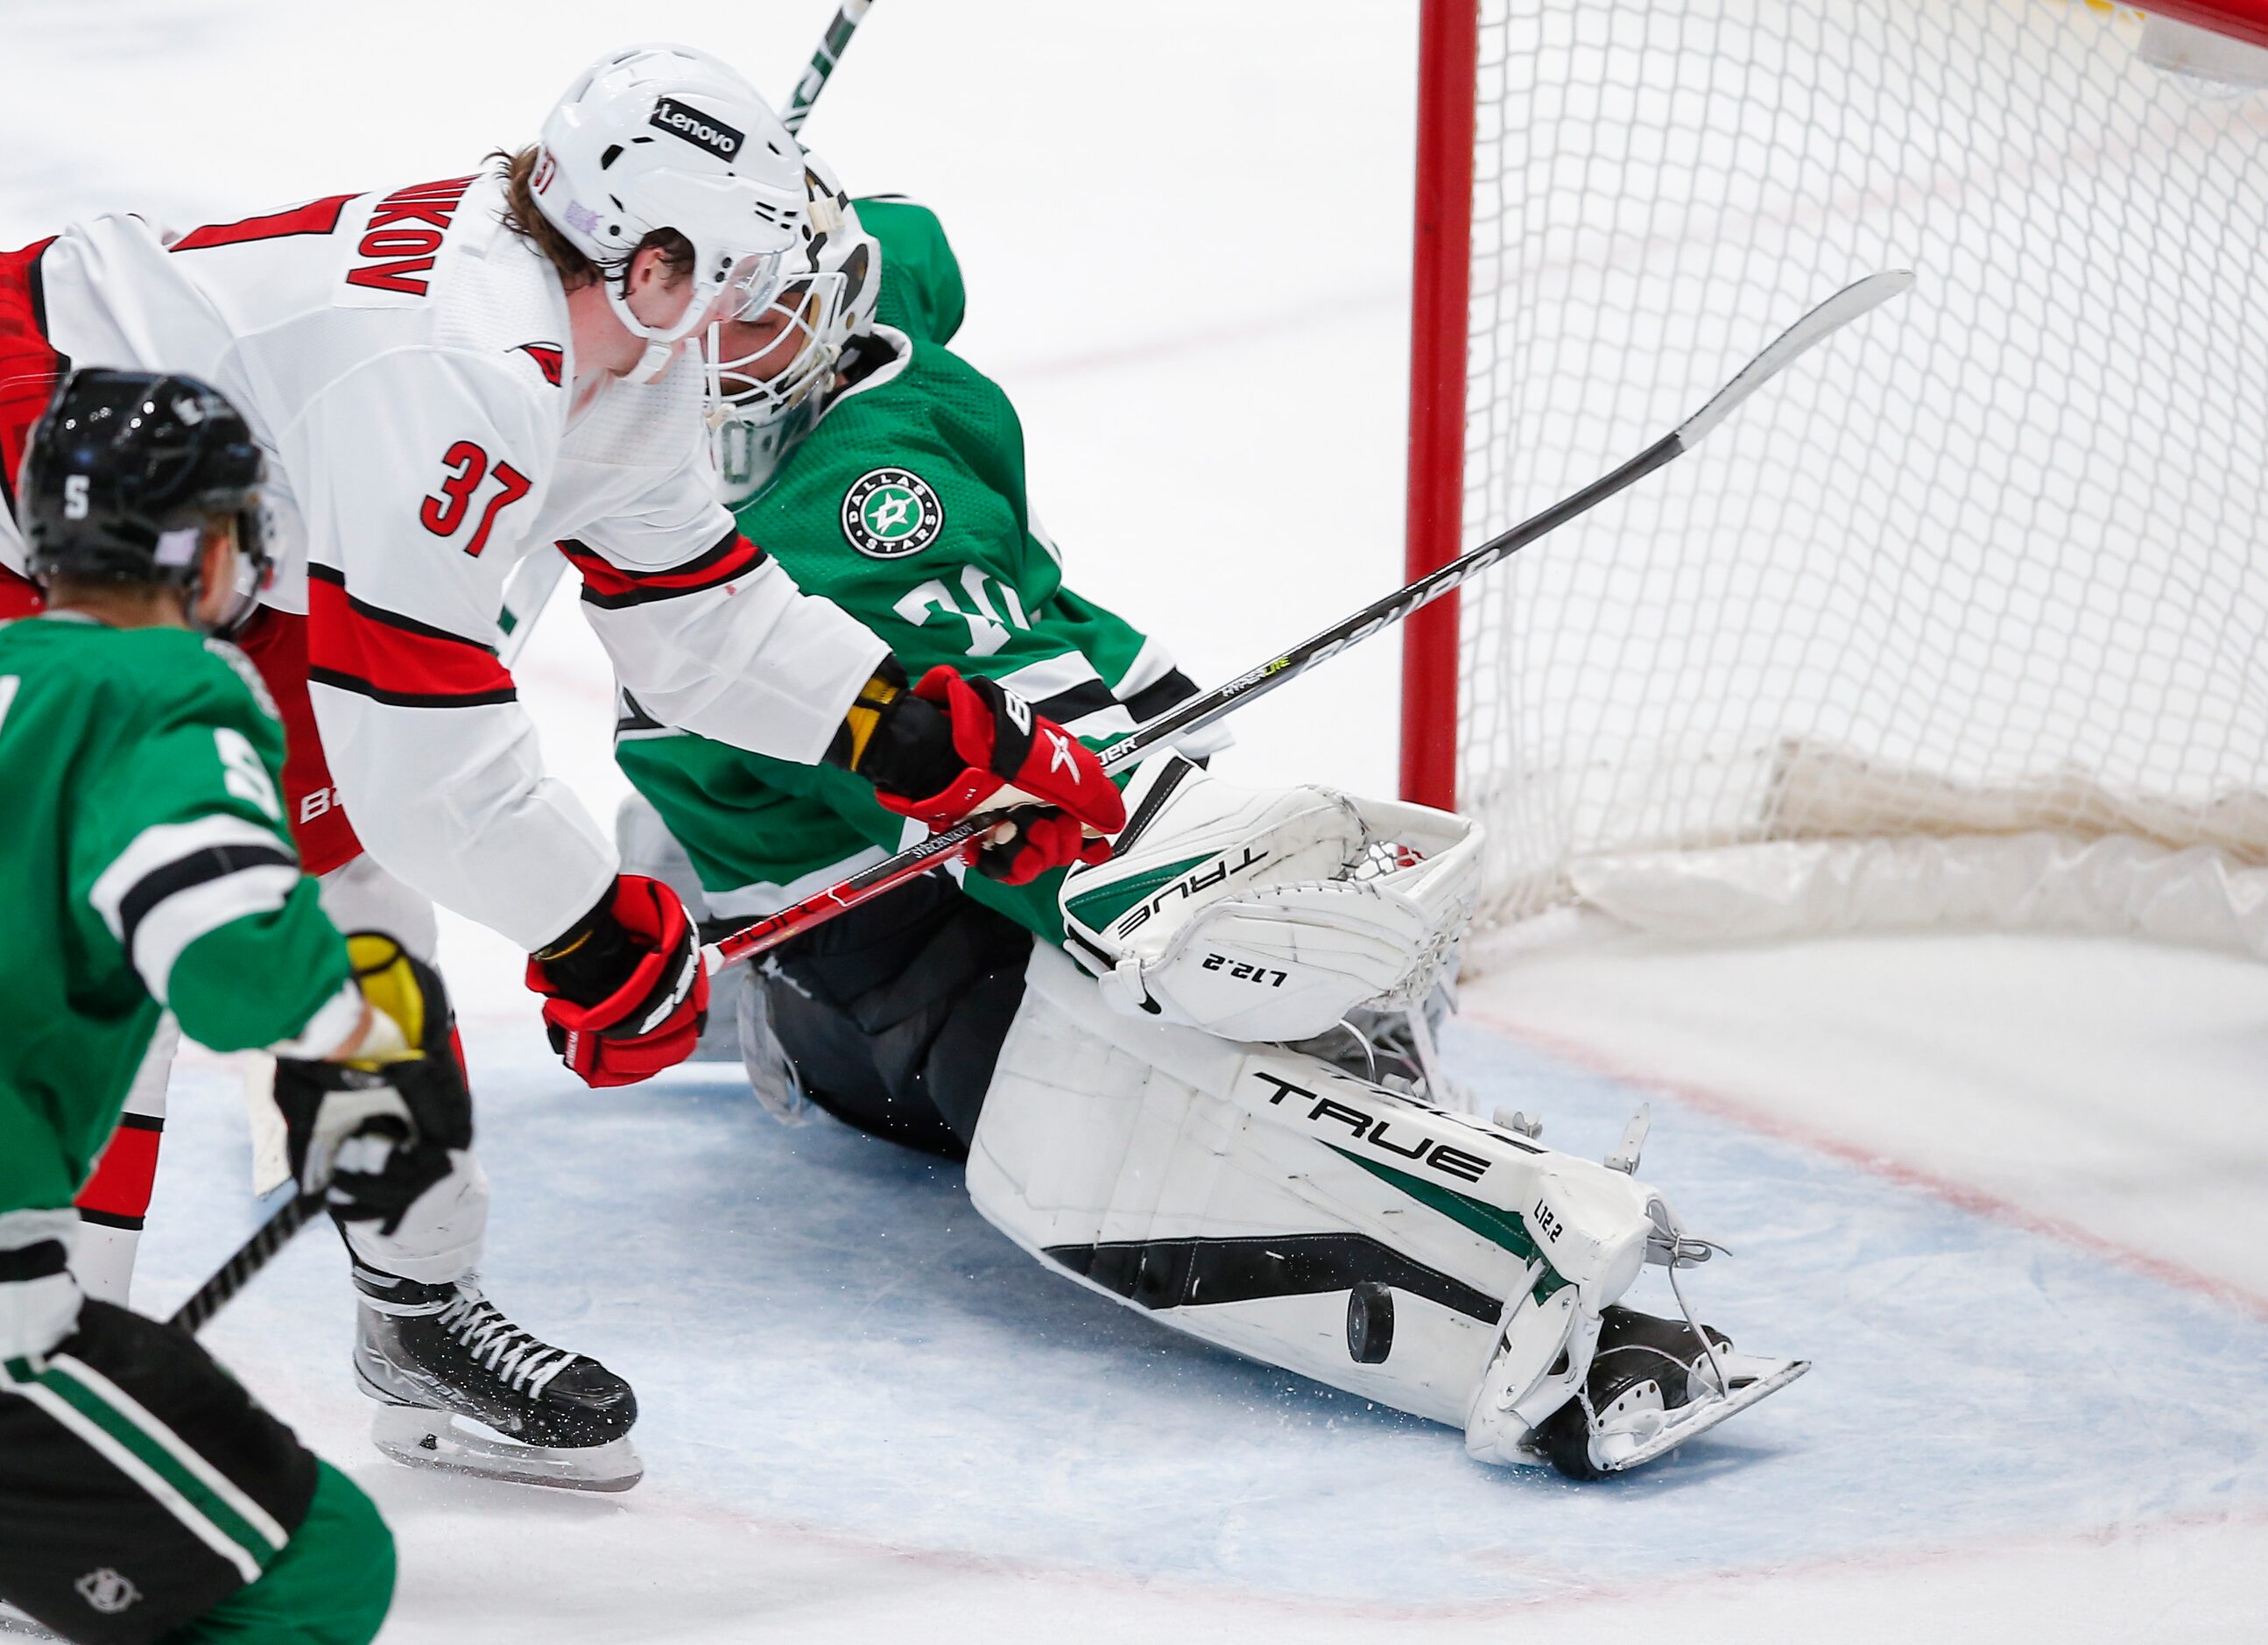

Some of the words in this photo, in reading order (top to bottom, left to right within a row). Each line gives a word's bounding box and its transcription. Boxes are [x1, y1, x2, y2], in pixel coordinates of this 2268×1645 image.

[659, 102, 736, 152] Lenovo
[420, 440, 532, 557] 37
[849, 474, 926, 524] DALLAS
[865, 514, 937, 554] STARS
[1117, 846, 1270, 942] TRUE
[1201, 952, 1288, 989] L12.2
[1253, 1071, 1493, 1183] TRUE
[1533, 1197, 1563, 1244] L12.2
